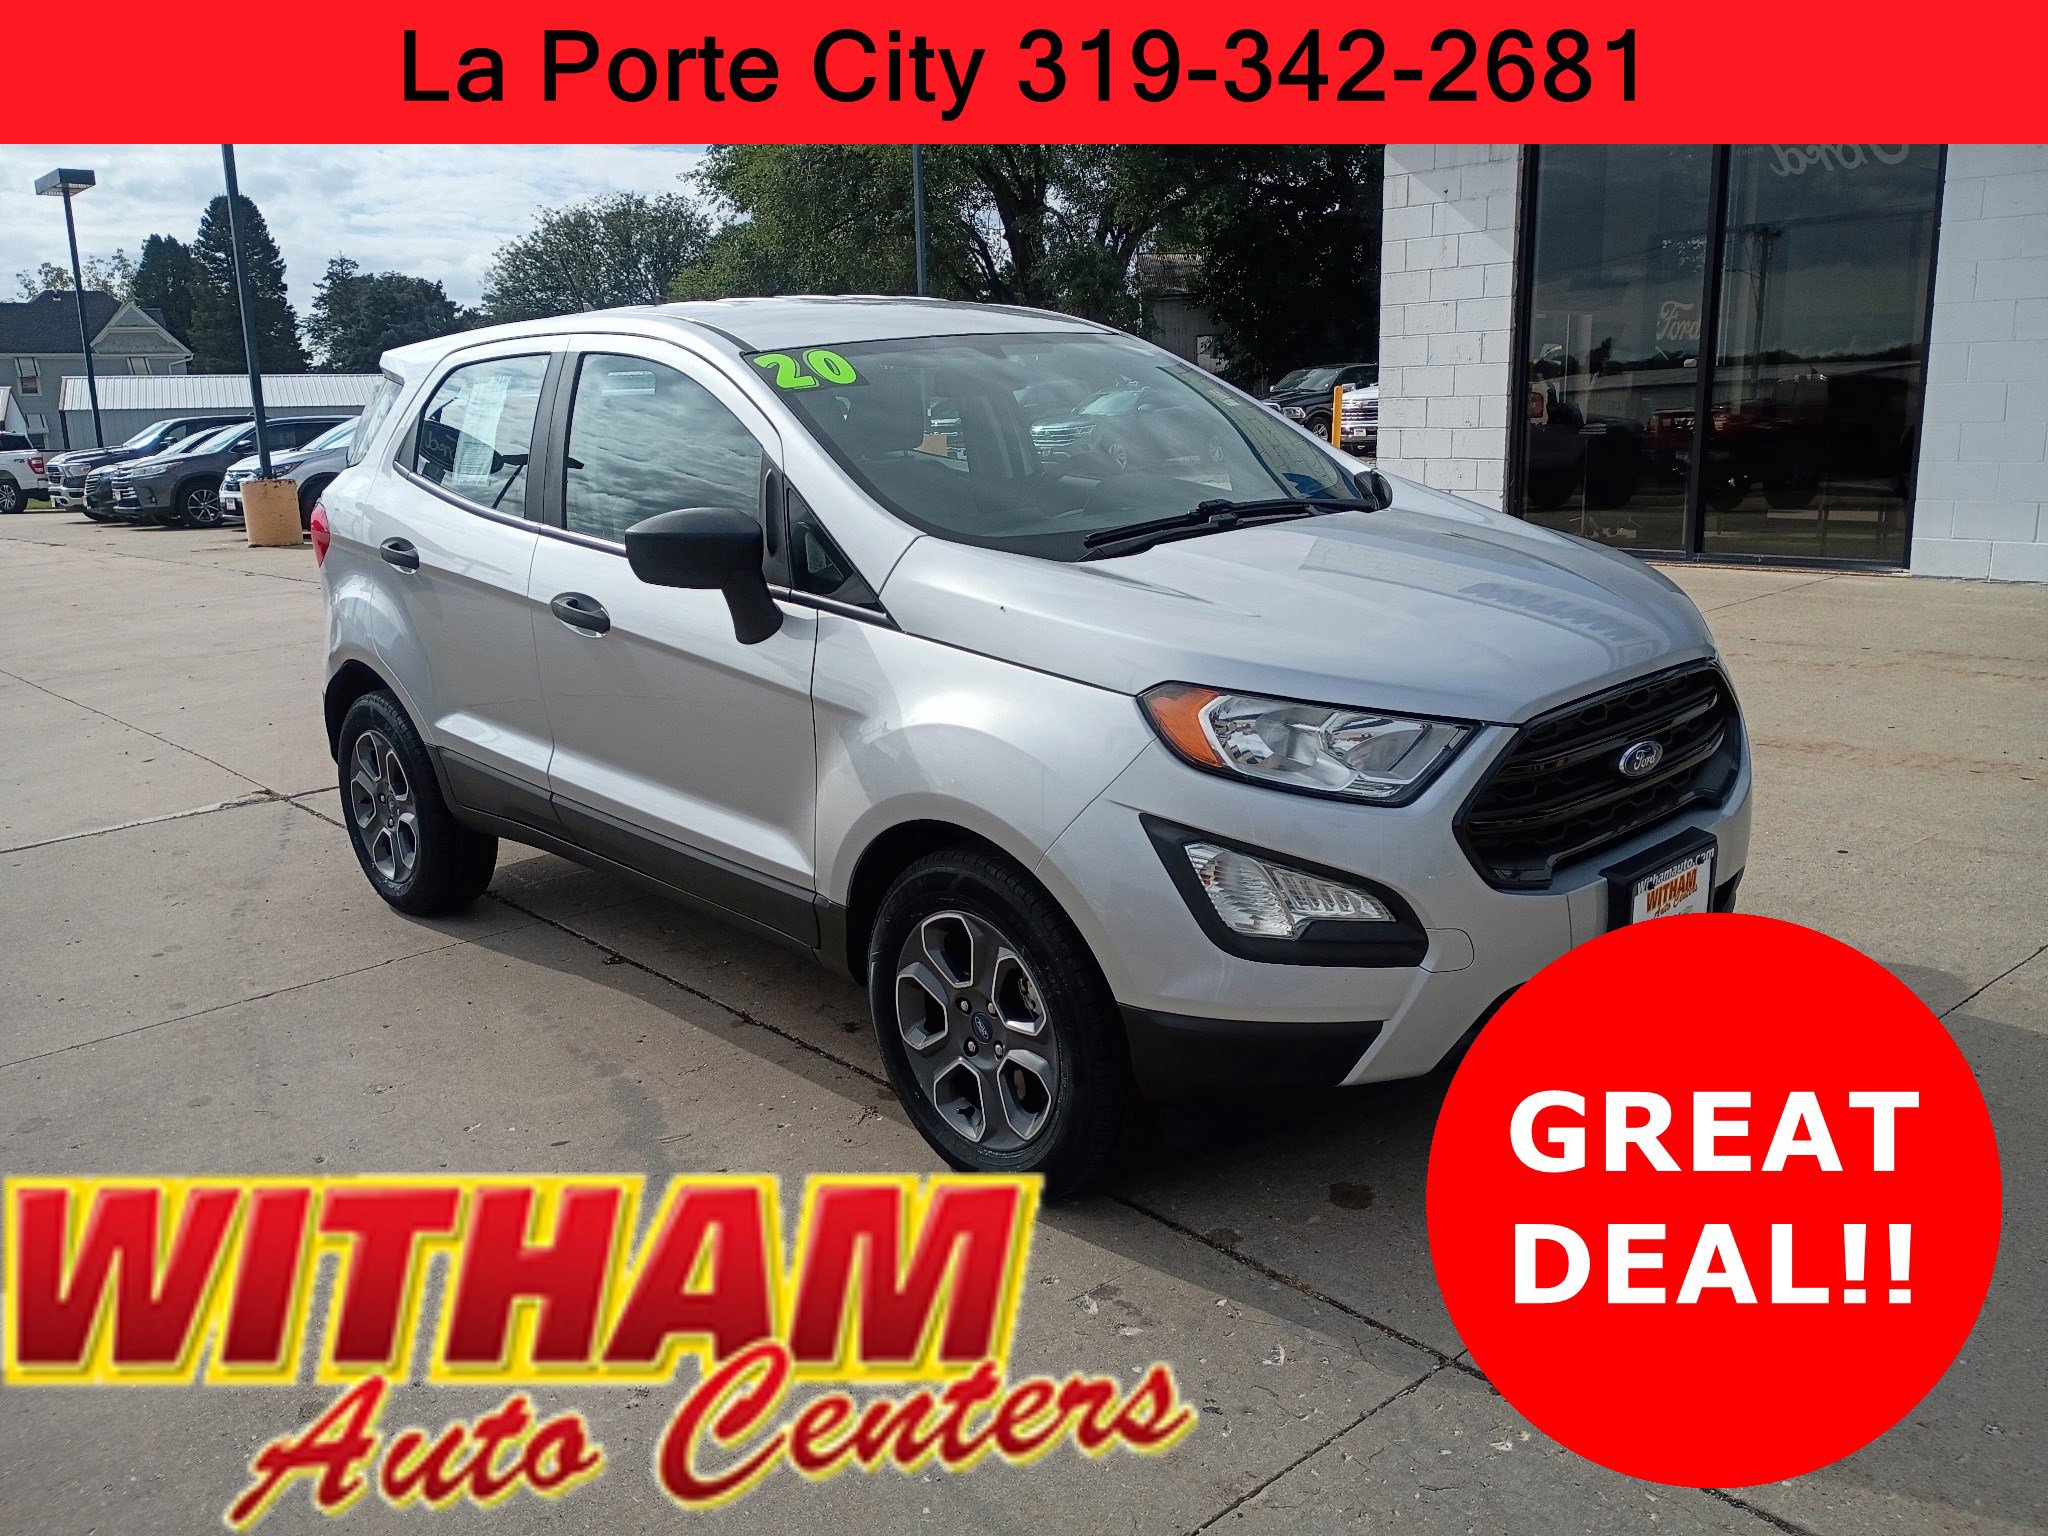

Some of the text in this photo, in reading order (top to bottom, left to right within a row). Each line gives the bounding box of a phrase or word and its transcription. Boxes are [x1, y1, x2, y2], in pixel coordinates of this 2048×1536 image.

[1656, 300, 1700, 340] Ford
[753, 348, 857, 389] 20
[1633, 747, 1657, 770] Ford
[1646, 868, 1698, 913] WITHAM
